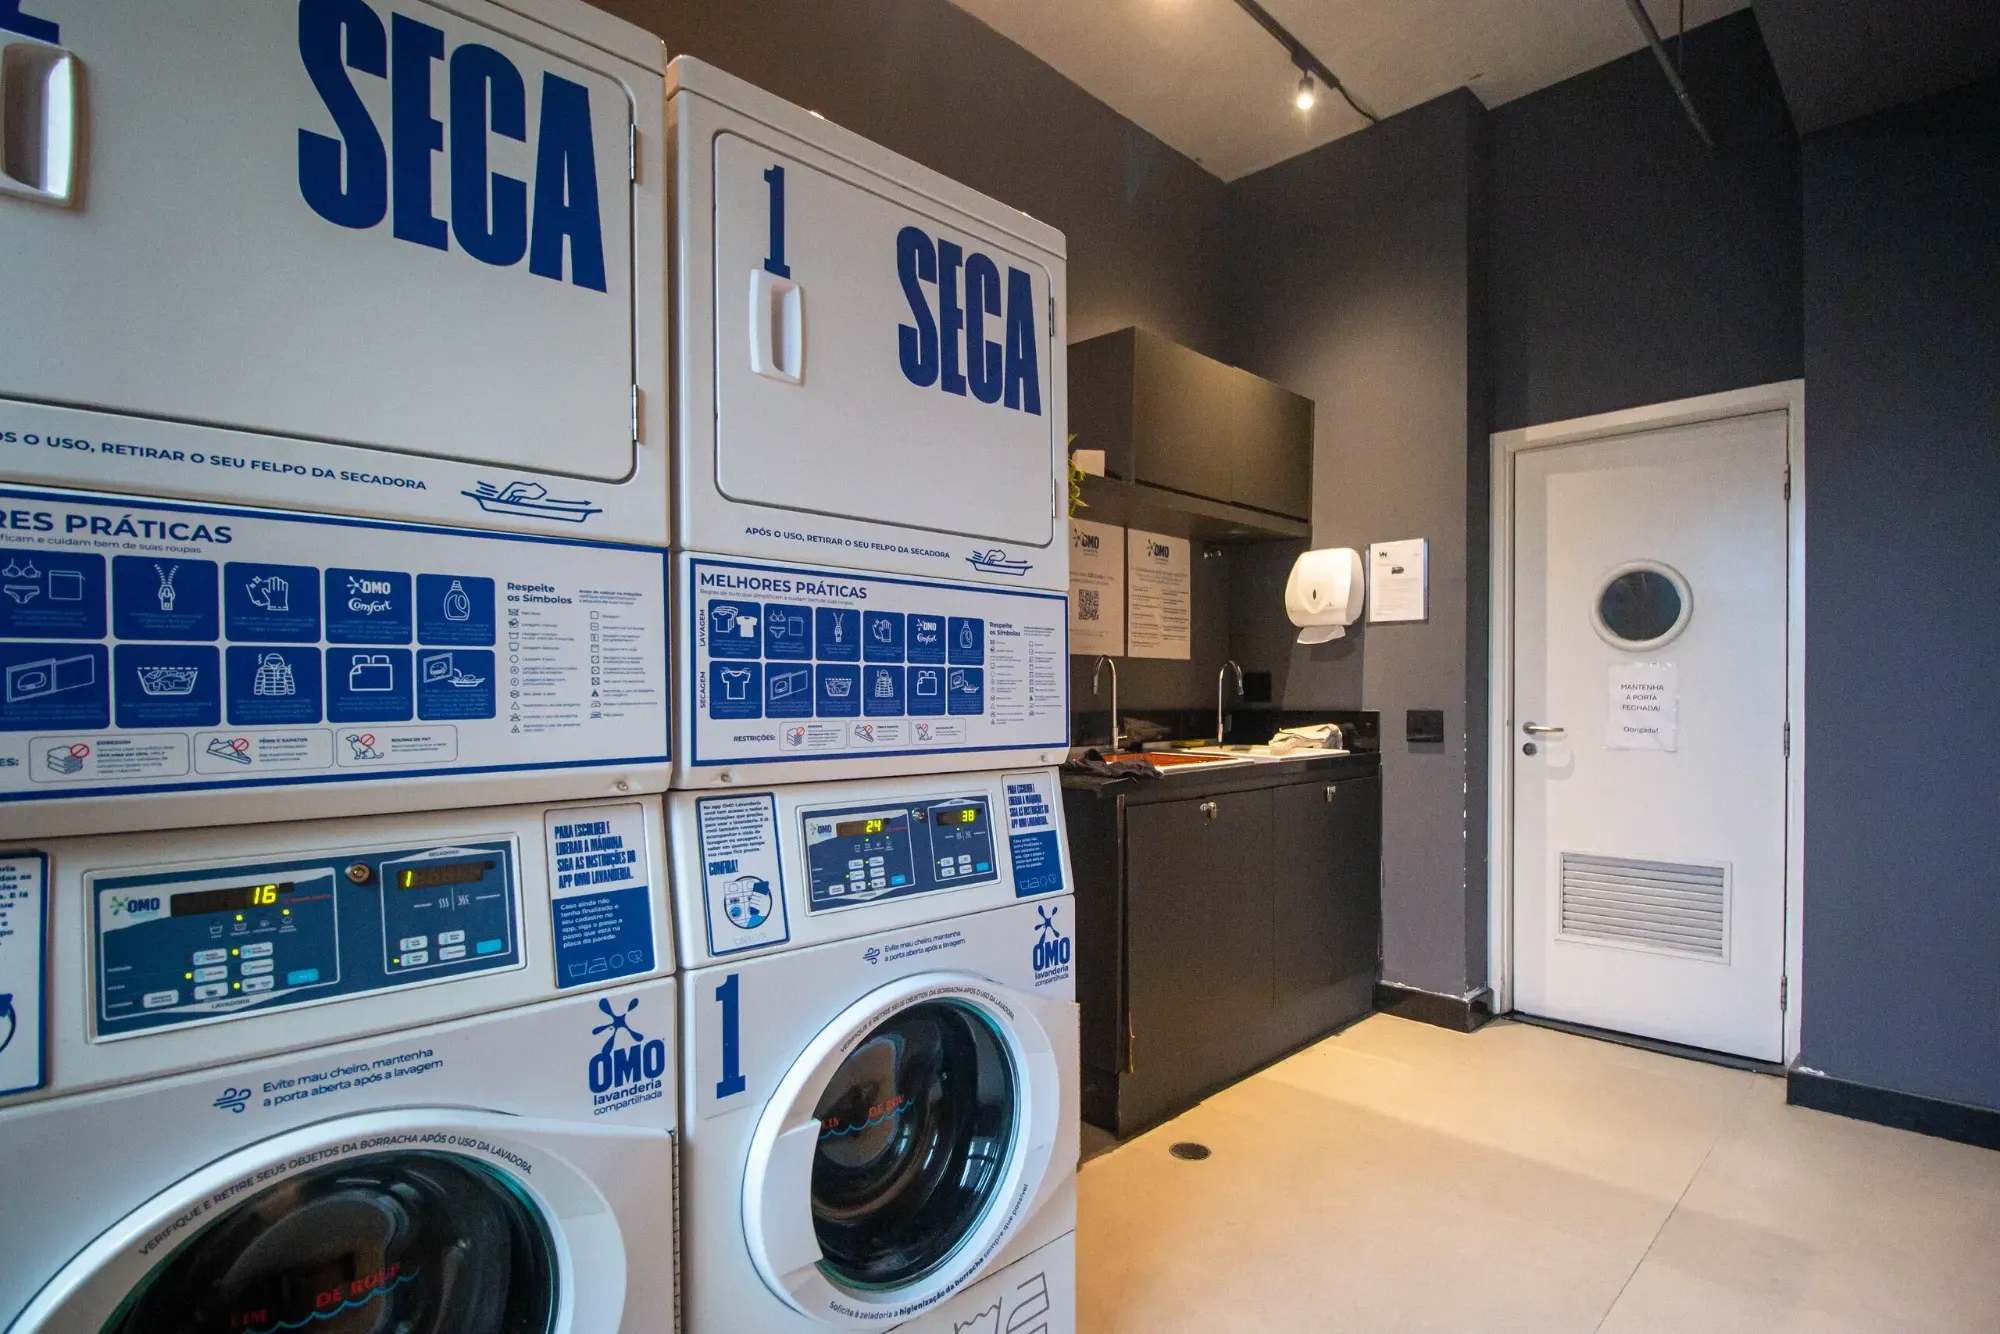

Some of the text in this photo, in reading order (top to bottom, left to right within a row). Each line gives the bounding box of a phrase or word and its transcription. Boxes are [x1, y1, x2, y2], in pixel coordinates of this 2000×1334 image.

[298, 0, 607, 293] SECA
[764, 164, 790, 279] 1
[897, 226, 1041, 416] SECA
[0, 431, 427, 490] S O USO, RETIRAR O SEU FELPO DA SECADORA
[66, 514, 233, 544] PRÁTICAS
[47, 536, 91, 547] cuidam
[94, 539, 120, 549] bem
[122, 542, 137, 550] de
[139, 544, 163, 552] suas
[166, 546, 202, 555] roupas
[745, 526, 771, 537] APÓS
[774, 530, 781, 538] O
[783, 532, 805, 542] USO,
[806, 534, 843, 546] RETIRAR
[853, 540, 869, 549] SEU
[871, 542, 896, 552] FELPO
[910, 547, 950, 559] SECADORA
[362, 581, 391, 595] OMO
[507, 582, 555, 594] Respeite
[701, 573, 867, 599] MELHORES PRÁTICAS
[348, 597, 393, 615] Comfort
[507, 594, 520, 602] os
[523, 594, 573, 605] Símbolos
[990, 622, 1013, 630] Respeite
[997, 629, 1020, 637] Símbolos
[962, 809, 974, 822] 38
[554, 824, 574, 840] PARA
[817, 825, 832, 834] OMO
[866, 820, 881, 833] 24
[557, 857, 574, 872] SIGA
[575, 855, 584, 870] AS
[558, 874, 572, 889] APP
[574, 872, 590, 886] OMO
[253, 884, 277, 905] 16
[127, 897, 160, 913] OMO
[561, 910, 580, 918] tenha
[582, 905, 613, 914] finalizado
[578, 900, 596, 908] ainda
[575, 914, 603, 923] cadastro
[578, 922, 591, 930] siga
[598, 919, 617, 928] passo
[563, 933, 582, 941] passo
[583, 930, 596, 938] que
[563, 939, 581, 949] placa
[884, 944, 899, 953] Evite
[933, 931, 961, 942] mantenha
[889, 952, 905, 961] porta
[905, 948, 924, 957] aberta
[942, 938, 965, 949] lavagem
[1032, 937, 1070, 971] OMO
[1035, 965, 1069, 980] lavanderia
[716, 973, 746, 1099] 1
[263, 1048, 434, 1093] Evite mau cheiro, mantenha
[588, 1039, 665, 1093] OMO
[263, 1099, 271, 1107] a
[274, 1089, 308, 1106] porta
[311, 1081, 351, 1096] aberta
[353, 1073, 382, 1088] após
[393, 1059, 443, 1078] lavagem
[594, 1079, 662, 1106] lavanderia
[593, 1090, 662, 1116] compartilhada
[139, 1207, 202, 1256] VERIFIQUE
[213, 1178, 254, 1204] RETIRE
[256, 1163, 286, 1183] SEUS
[288, 1146, 339, 1169] OBJETOS
[342, 1141, 358, 1154] DA
[360, 1134, 418, 1150] BORRACHA
[420, 1132, 446, 1144] APÓS
[448, 1135, 456, 1144] O
[457, 1136, 477, 1148] USO
[477, 1140, 490, 1152] DA
[829, 1300, 853, 1317] Solicite
[859, 1311, 892, 1319] zeladoria
[899, 1291, 945, 1316] higienização
[946, 1284, 955, 1294] da
[954, 1258, 984, 1287] borracha
[983, 1231, 1003, 1258] sempre
[1003, 1216, 1014, 1231] que
